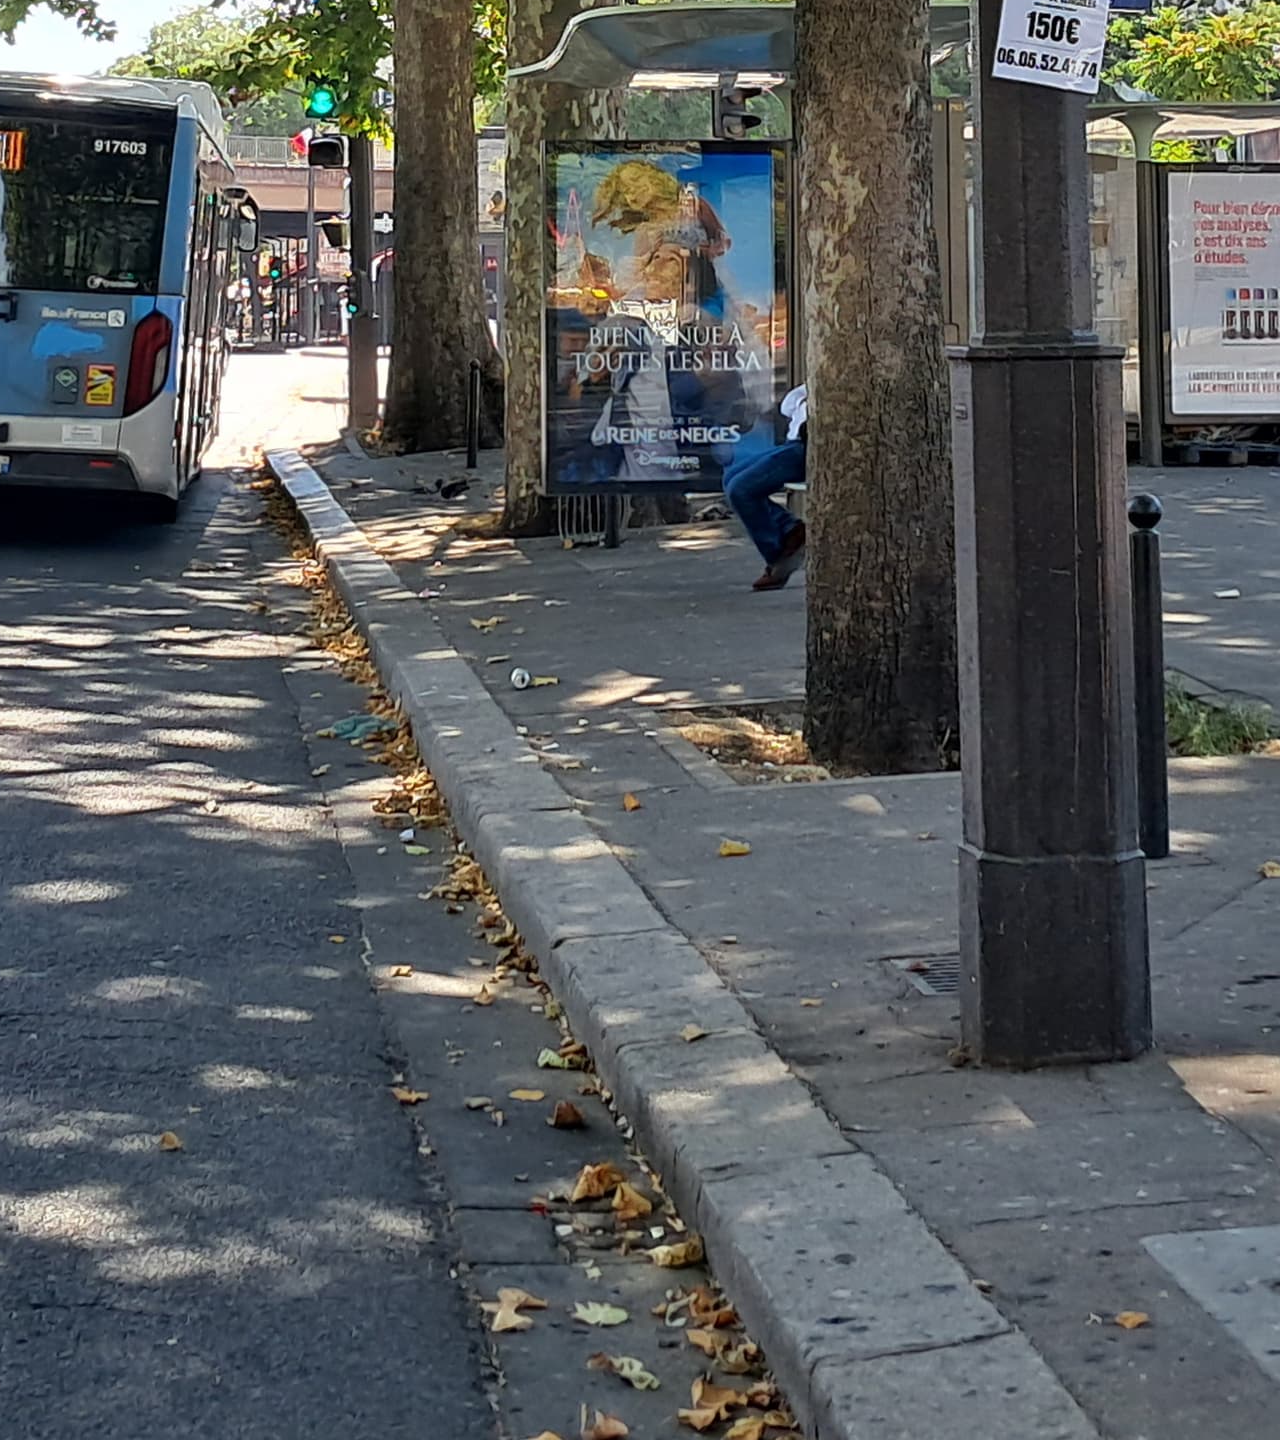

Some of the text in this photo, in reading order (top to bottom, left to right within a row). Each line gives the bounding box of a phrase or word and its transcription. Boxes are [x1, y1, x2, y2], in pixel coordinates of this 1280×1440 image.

[1027, 11, 1081, 44] 150€
[93, 138, 148, 156] 917603
[1193, 200, 1221, 215] Pour
[1222, 200, 1250, 215] bien
[1193, 217, 1273, 234] vos analyses,
[1224, 234, 1244, 248] dix
[728, 321, 745, 346] À
[570, 350, 761, 373] TOUTES LES ELSA
[606, 426, 659, 444] REINE
[659, 429, 680, 441] DES
[680, 424, 741, 444] NEIGES
